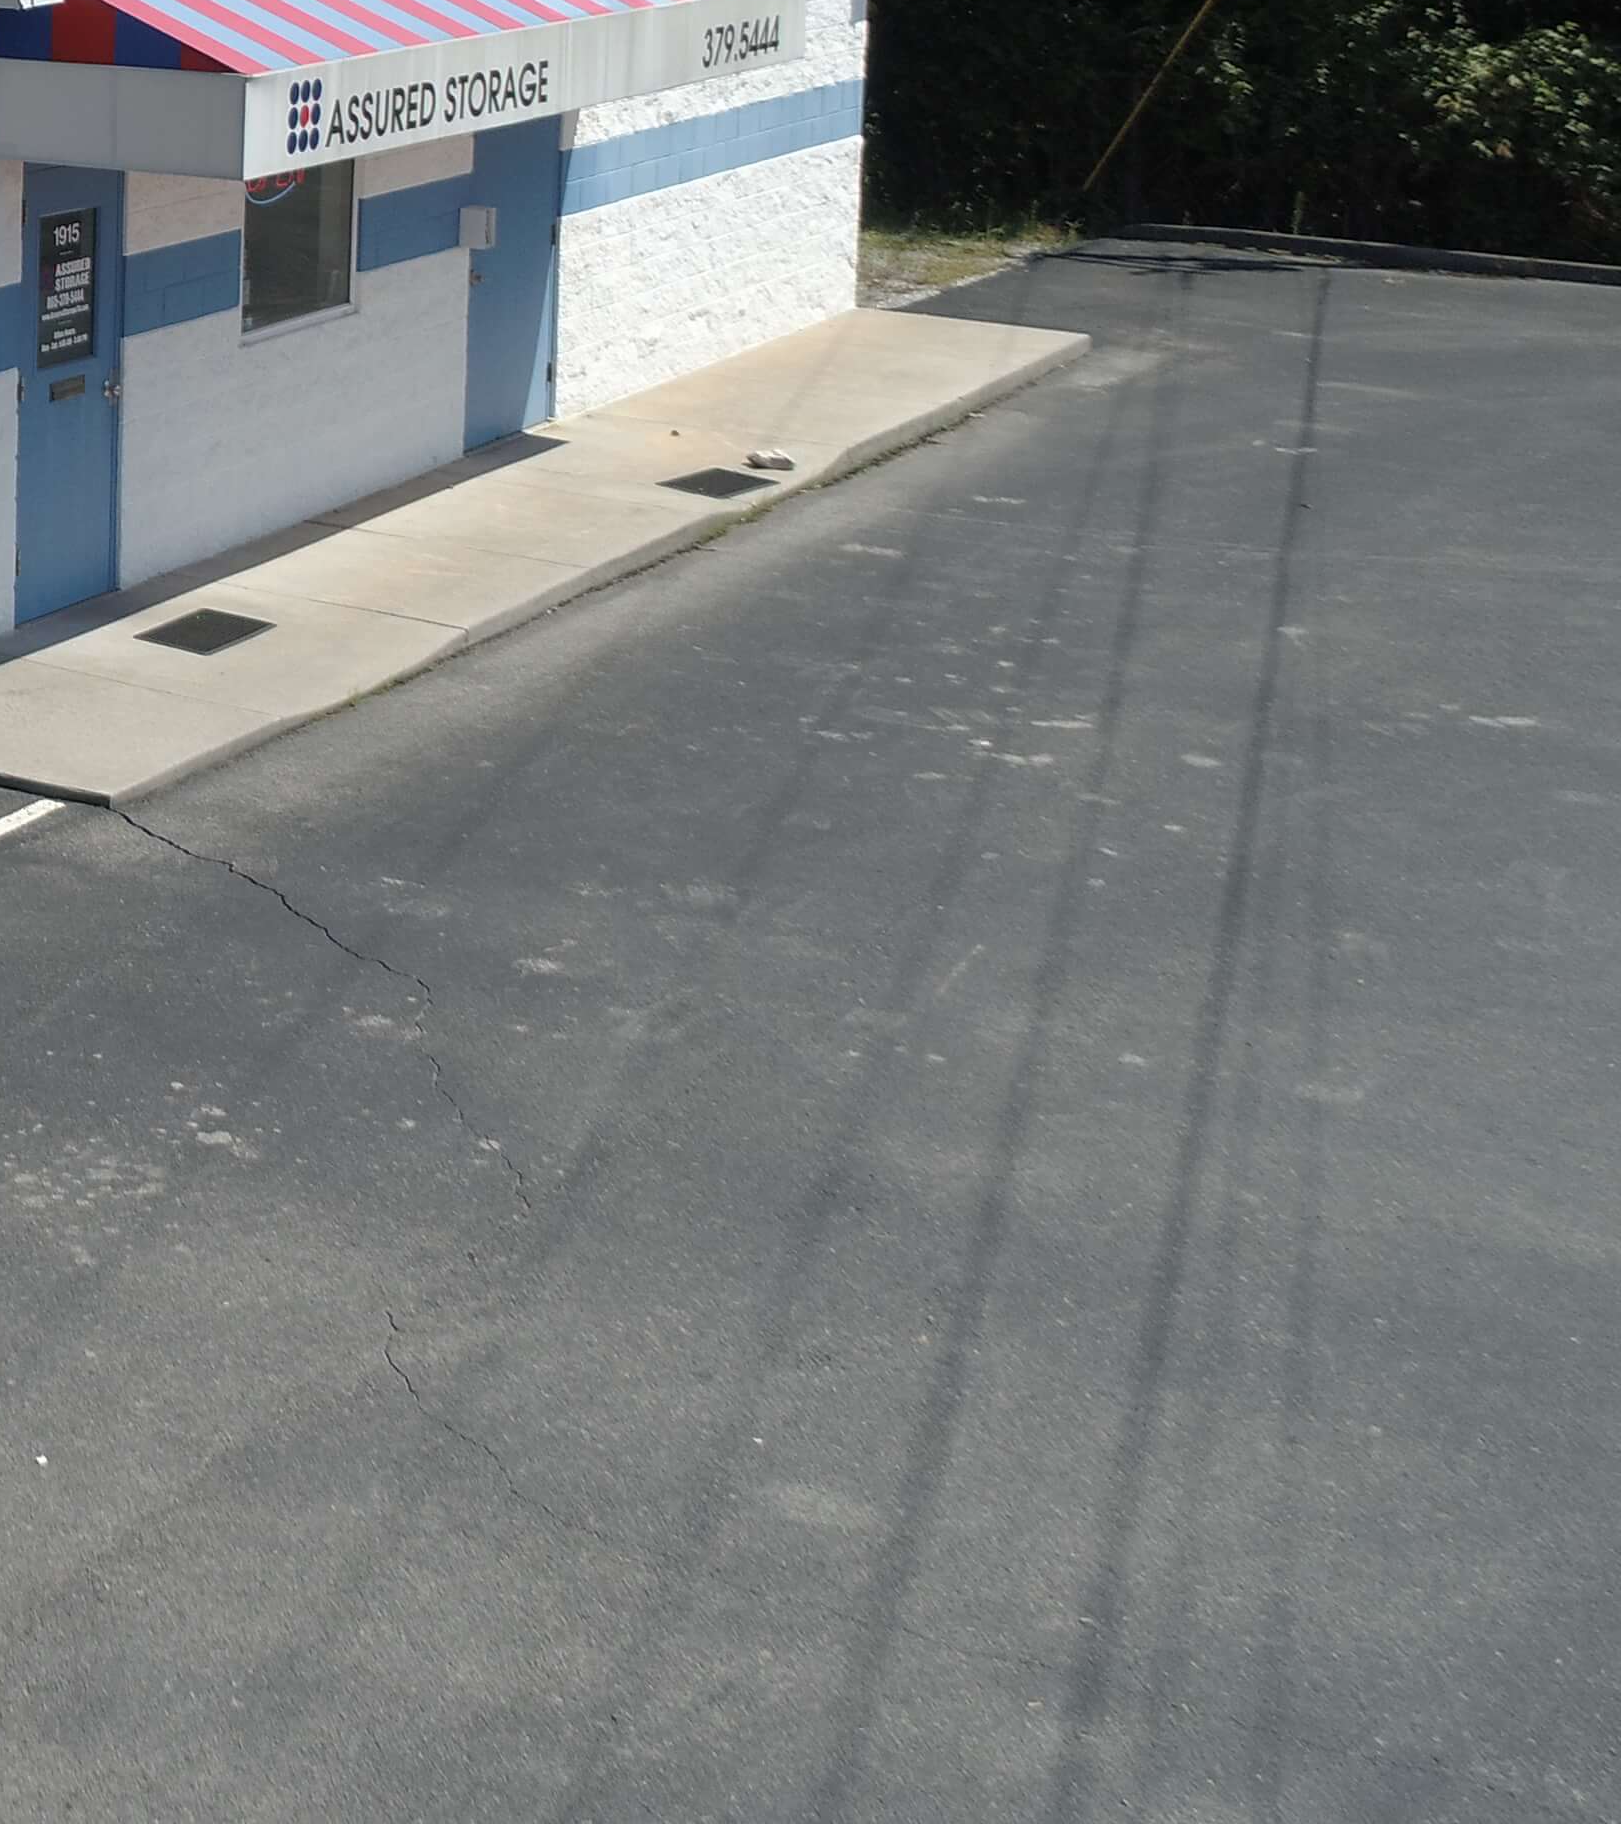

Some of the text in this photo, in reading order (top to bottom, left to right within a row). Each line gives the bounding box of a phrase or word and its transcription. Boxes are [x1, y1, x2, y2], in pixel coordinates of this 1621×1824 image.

[702, 14, 780, 68] 379.5444
[325, 60, 548, 147] ASSURED STORAGE
[53, 222, 80, 247] 1915
[54, 271, 90, 291] STORAGE
